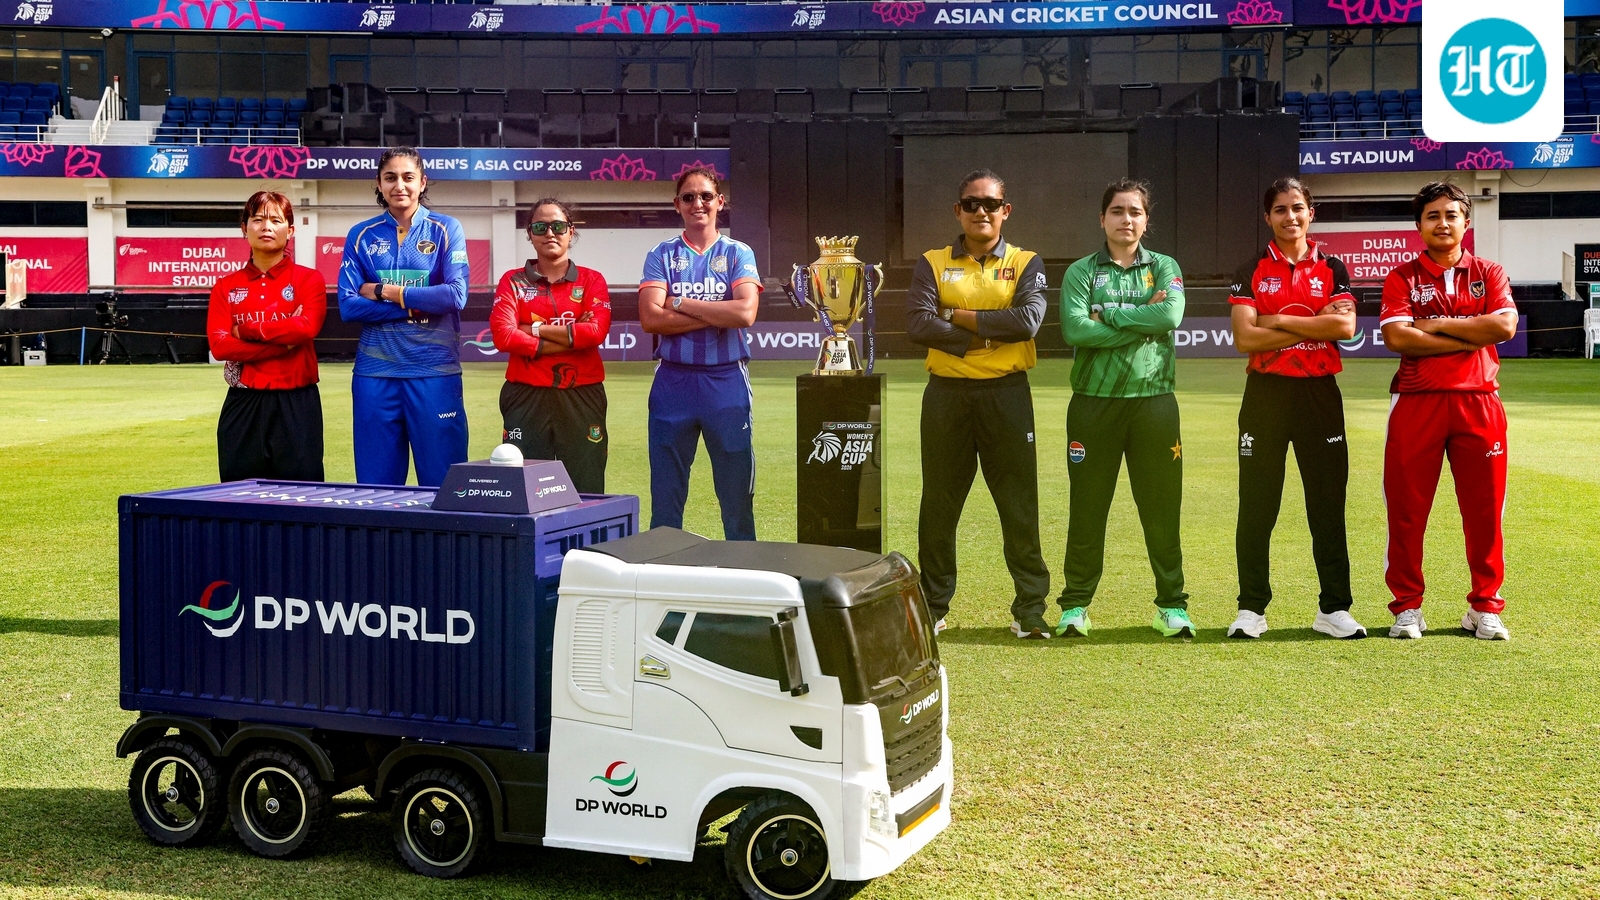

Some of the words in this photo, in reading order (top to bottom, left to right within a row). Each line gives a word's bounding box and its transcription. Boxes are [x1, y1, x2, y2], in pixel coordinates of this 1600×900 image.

[933, 8, 1004, 24] ASIAN
[1010, 6, 1108, 23] CRICKET
[1114, 3, 1218, 21] COUNCIL
[1330, 150, 1414, 165] STADIUM
[1553, 148, 1575, 156] ASIA
[170, 158, 189, 167] ASIA
[306, 158, 328, 170] DP
[332, 158, 379, 170] WORL
[423, 158, 469, 170] MEN'S
[474, 160, 510, 171] ASIA
[513, 160, 544, 171] CUP
[547, 160, 582, 171] 2026
[1552, 155, 1570, 163] CUP
[1363, 238, 1406, 250] DUBAI
[182, 247, 226, 258] DUBAI
[1329, 251, 1421, 264] NTERNATION
[148, 261, 248, 272] INTERNATION
[1354, 266, 1397, 277] STAD
[172, 275, 222, 286] STADI
[867, 281, 872, 291] DP
[672, 277, 727, 298] apollo
[1421, 289, 1436, 297] ASIA
[688, 293, 725, 301] TYRES
[1126, 290, 1144, 298] TEL
[1420, 295, 1433, 303] CUP
[233, 311, 292, 325] HAILAN
[756, 332, 821, 348] WORL
[1175, 330, 1207, 346] DP
[508, 427, 523, 440] রবি
[842, 441, 873, 453] ASIA
[840, 452, 867, 465] CUP
[468, 489, 480, 497] DP
[481, 489, 512, 498] WORLD
[541, 487, 550, 496] DP
[550, 484, 567, 494] WORLD
[254, 595, 310, 631] DP
[315, 600, 475, 645] WORLD
[912, 701, 922, 717] DP
[922, 689, 939, 711] WORLD
[575, 798, 600, 813] DP
[602, 801, 667, 819] WORLD
